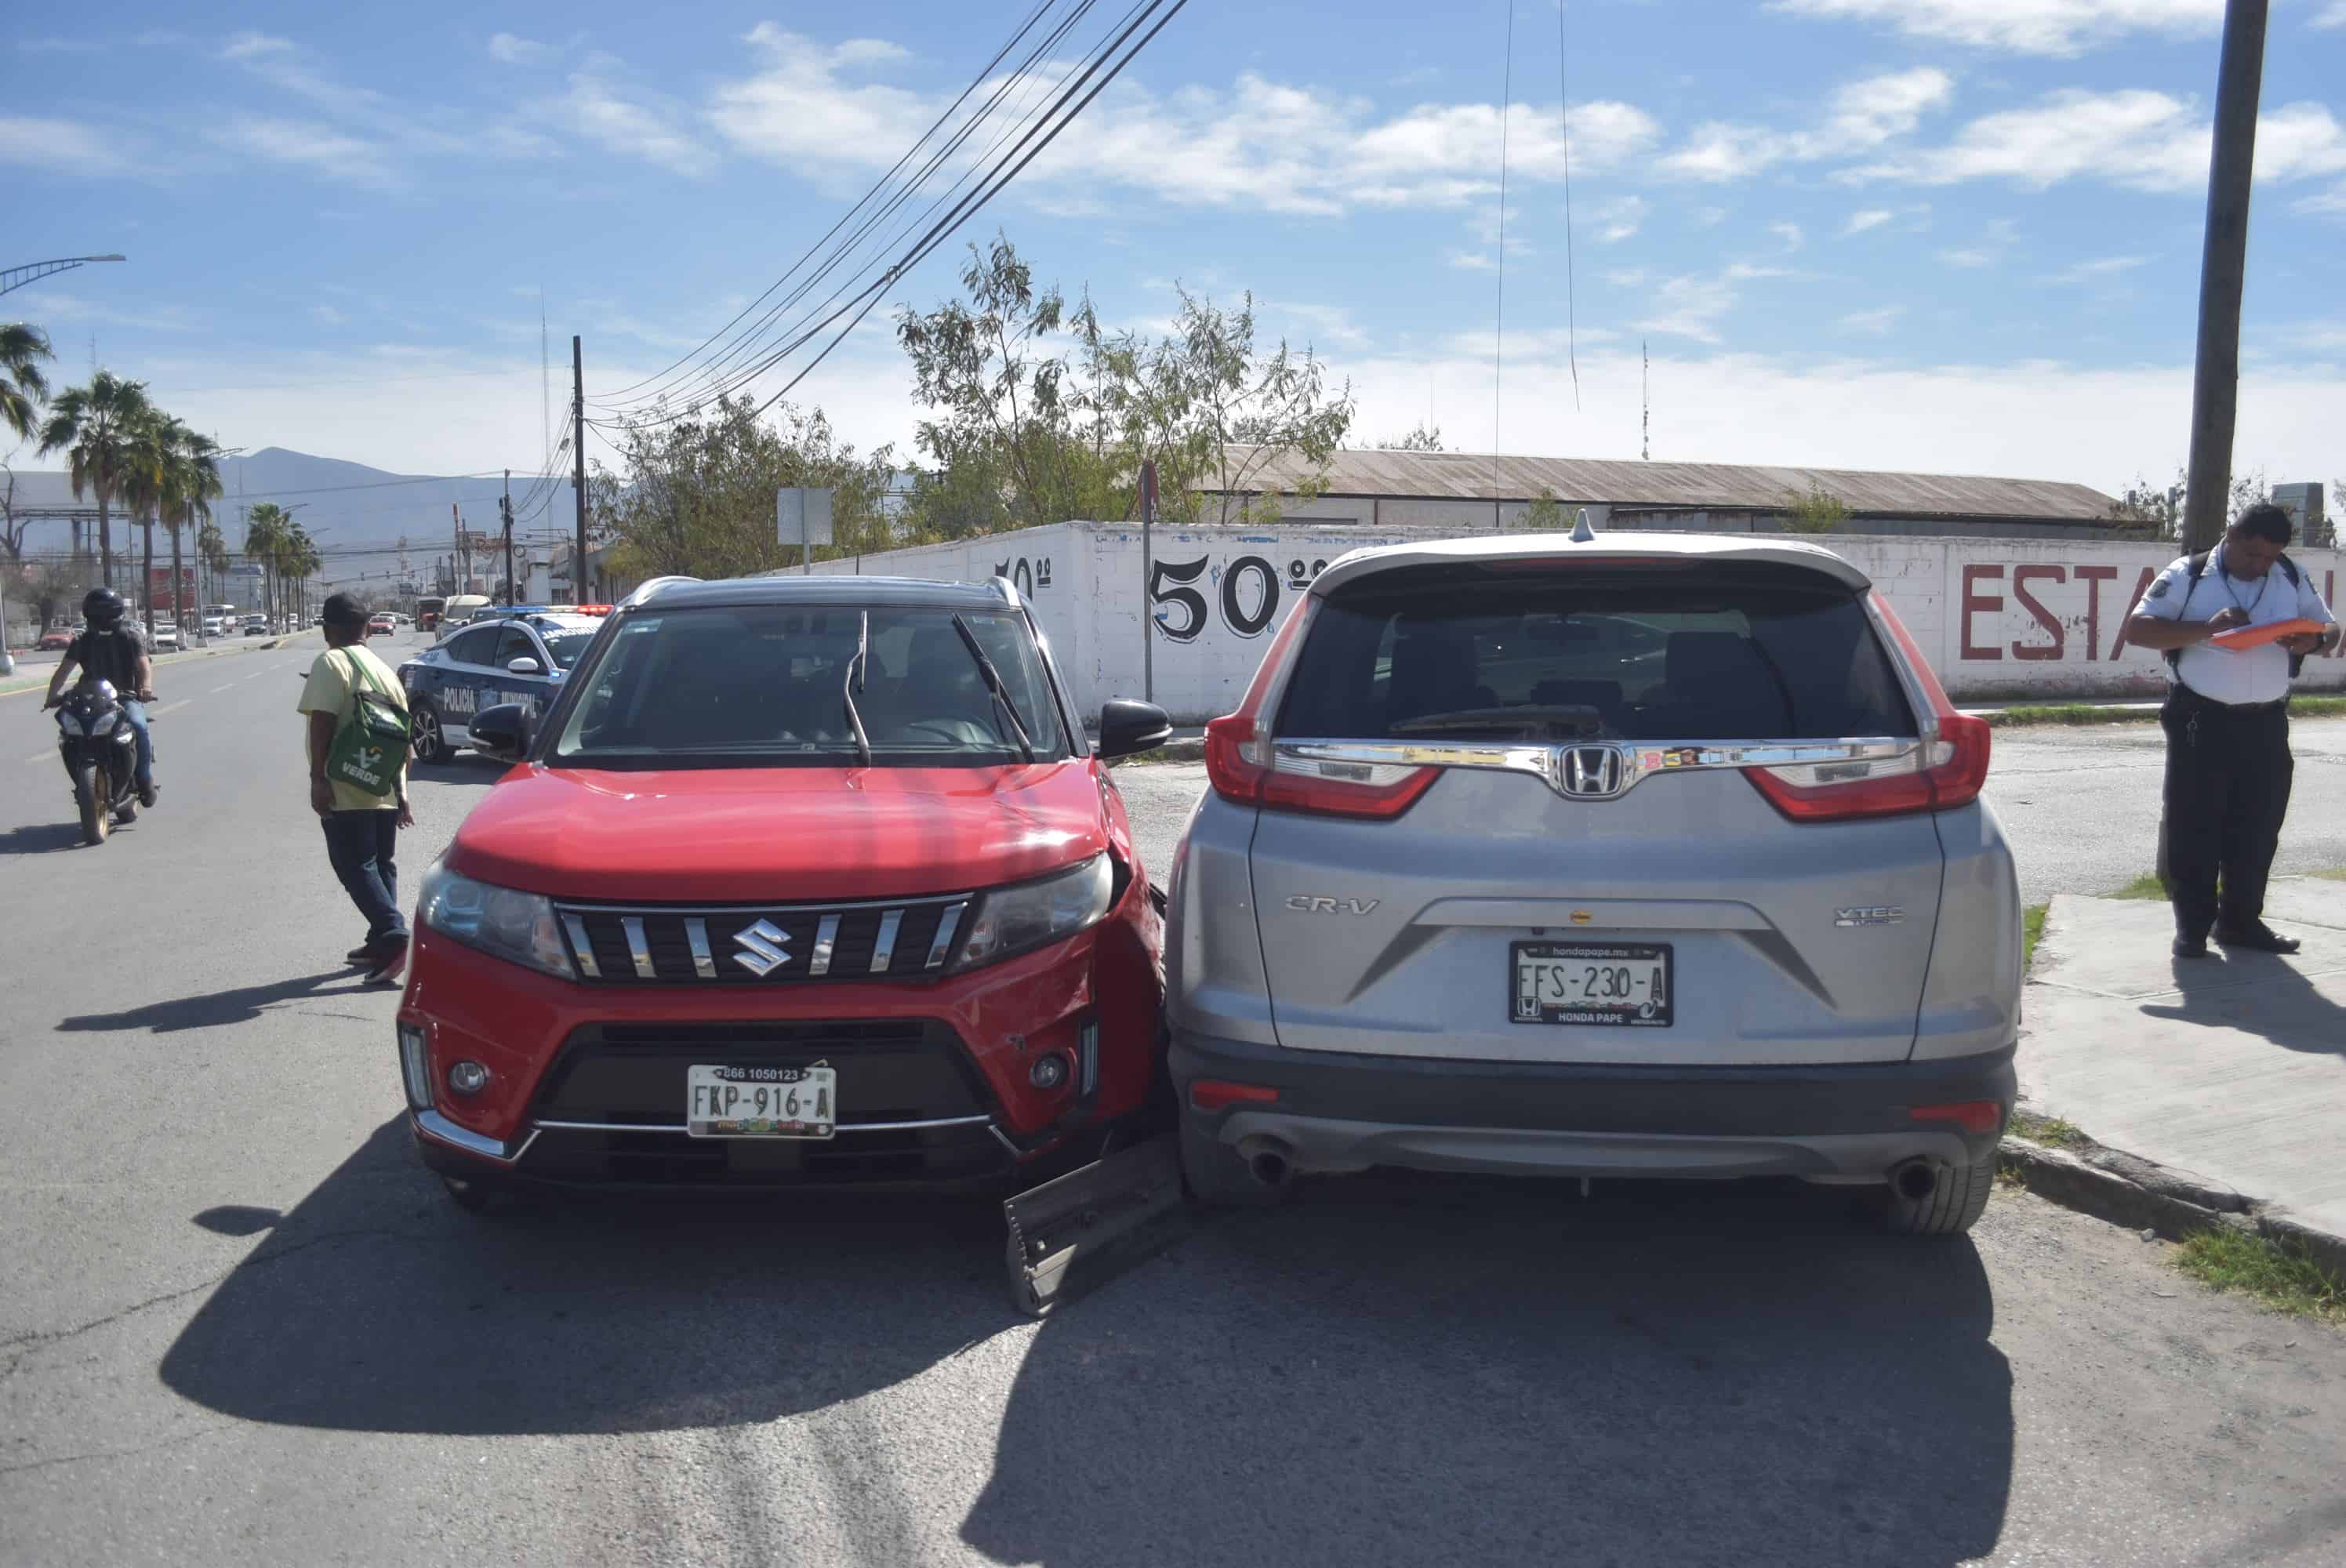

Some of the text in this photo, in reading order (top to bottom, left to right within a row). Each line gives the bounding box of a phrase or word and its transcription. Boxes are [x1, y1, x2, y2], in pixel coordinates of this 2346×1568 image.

[342, 760, 382, 786] VERDE
[1285, 895, 1381, 916] CR-V
[1552, 946, 1629, 958] hondapape.mx
[1558, 1011, 1595, 1023] HONDA
[1596, 1013, 1624, 1024] PAPE
[724, 1067, 798, 1080] 866 1050123
[694, 1085, 830, 1118] FKP-916-A
